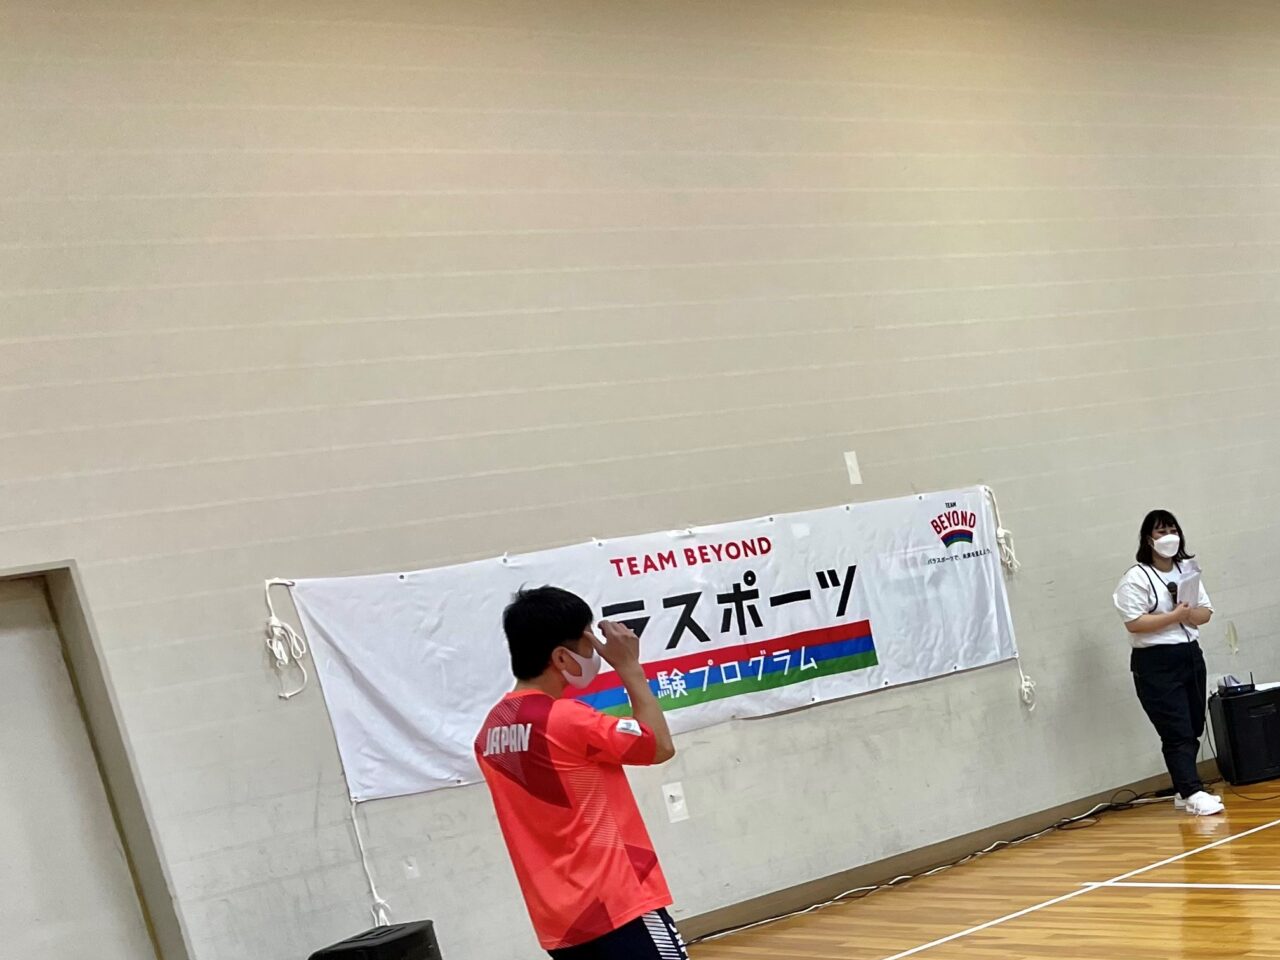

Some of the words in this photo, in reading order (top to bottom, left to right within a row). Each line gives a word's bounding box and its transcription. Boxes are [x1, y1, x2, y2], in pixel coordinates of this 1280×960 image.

[930, 510, 976, 535] BEYOND
[609, 550, 678, 577] TEAM
[683, 536, 772, 566] BEYOND
[601, 564, 857, 650] ラスポーツ
[624, 646, 818, 706] 験プログラム
[483, 723, 532, 757] JAPAN
